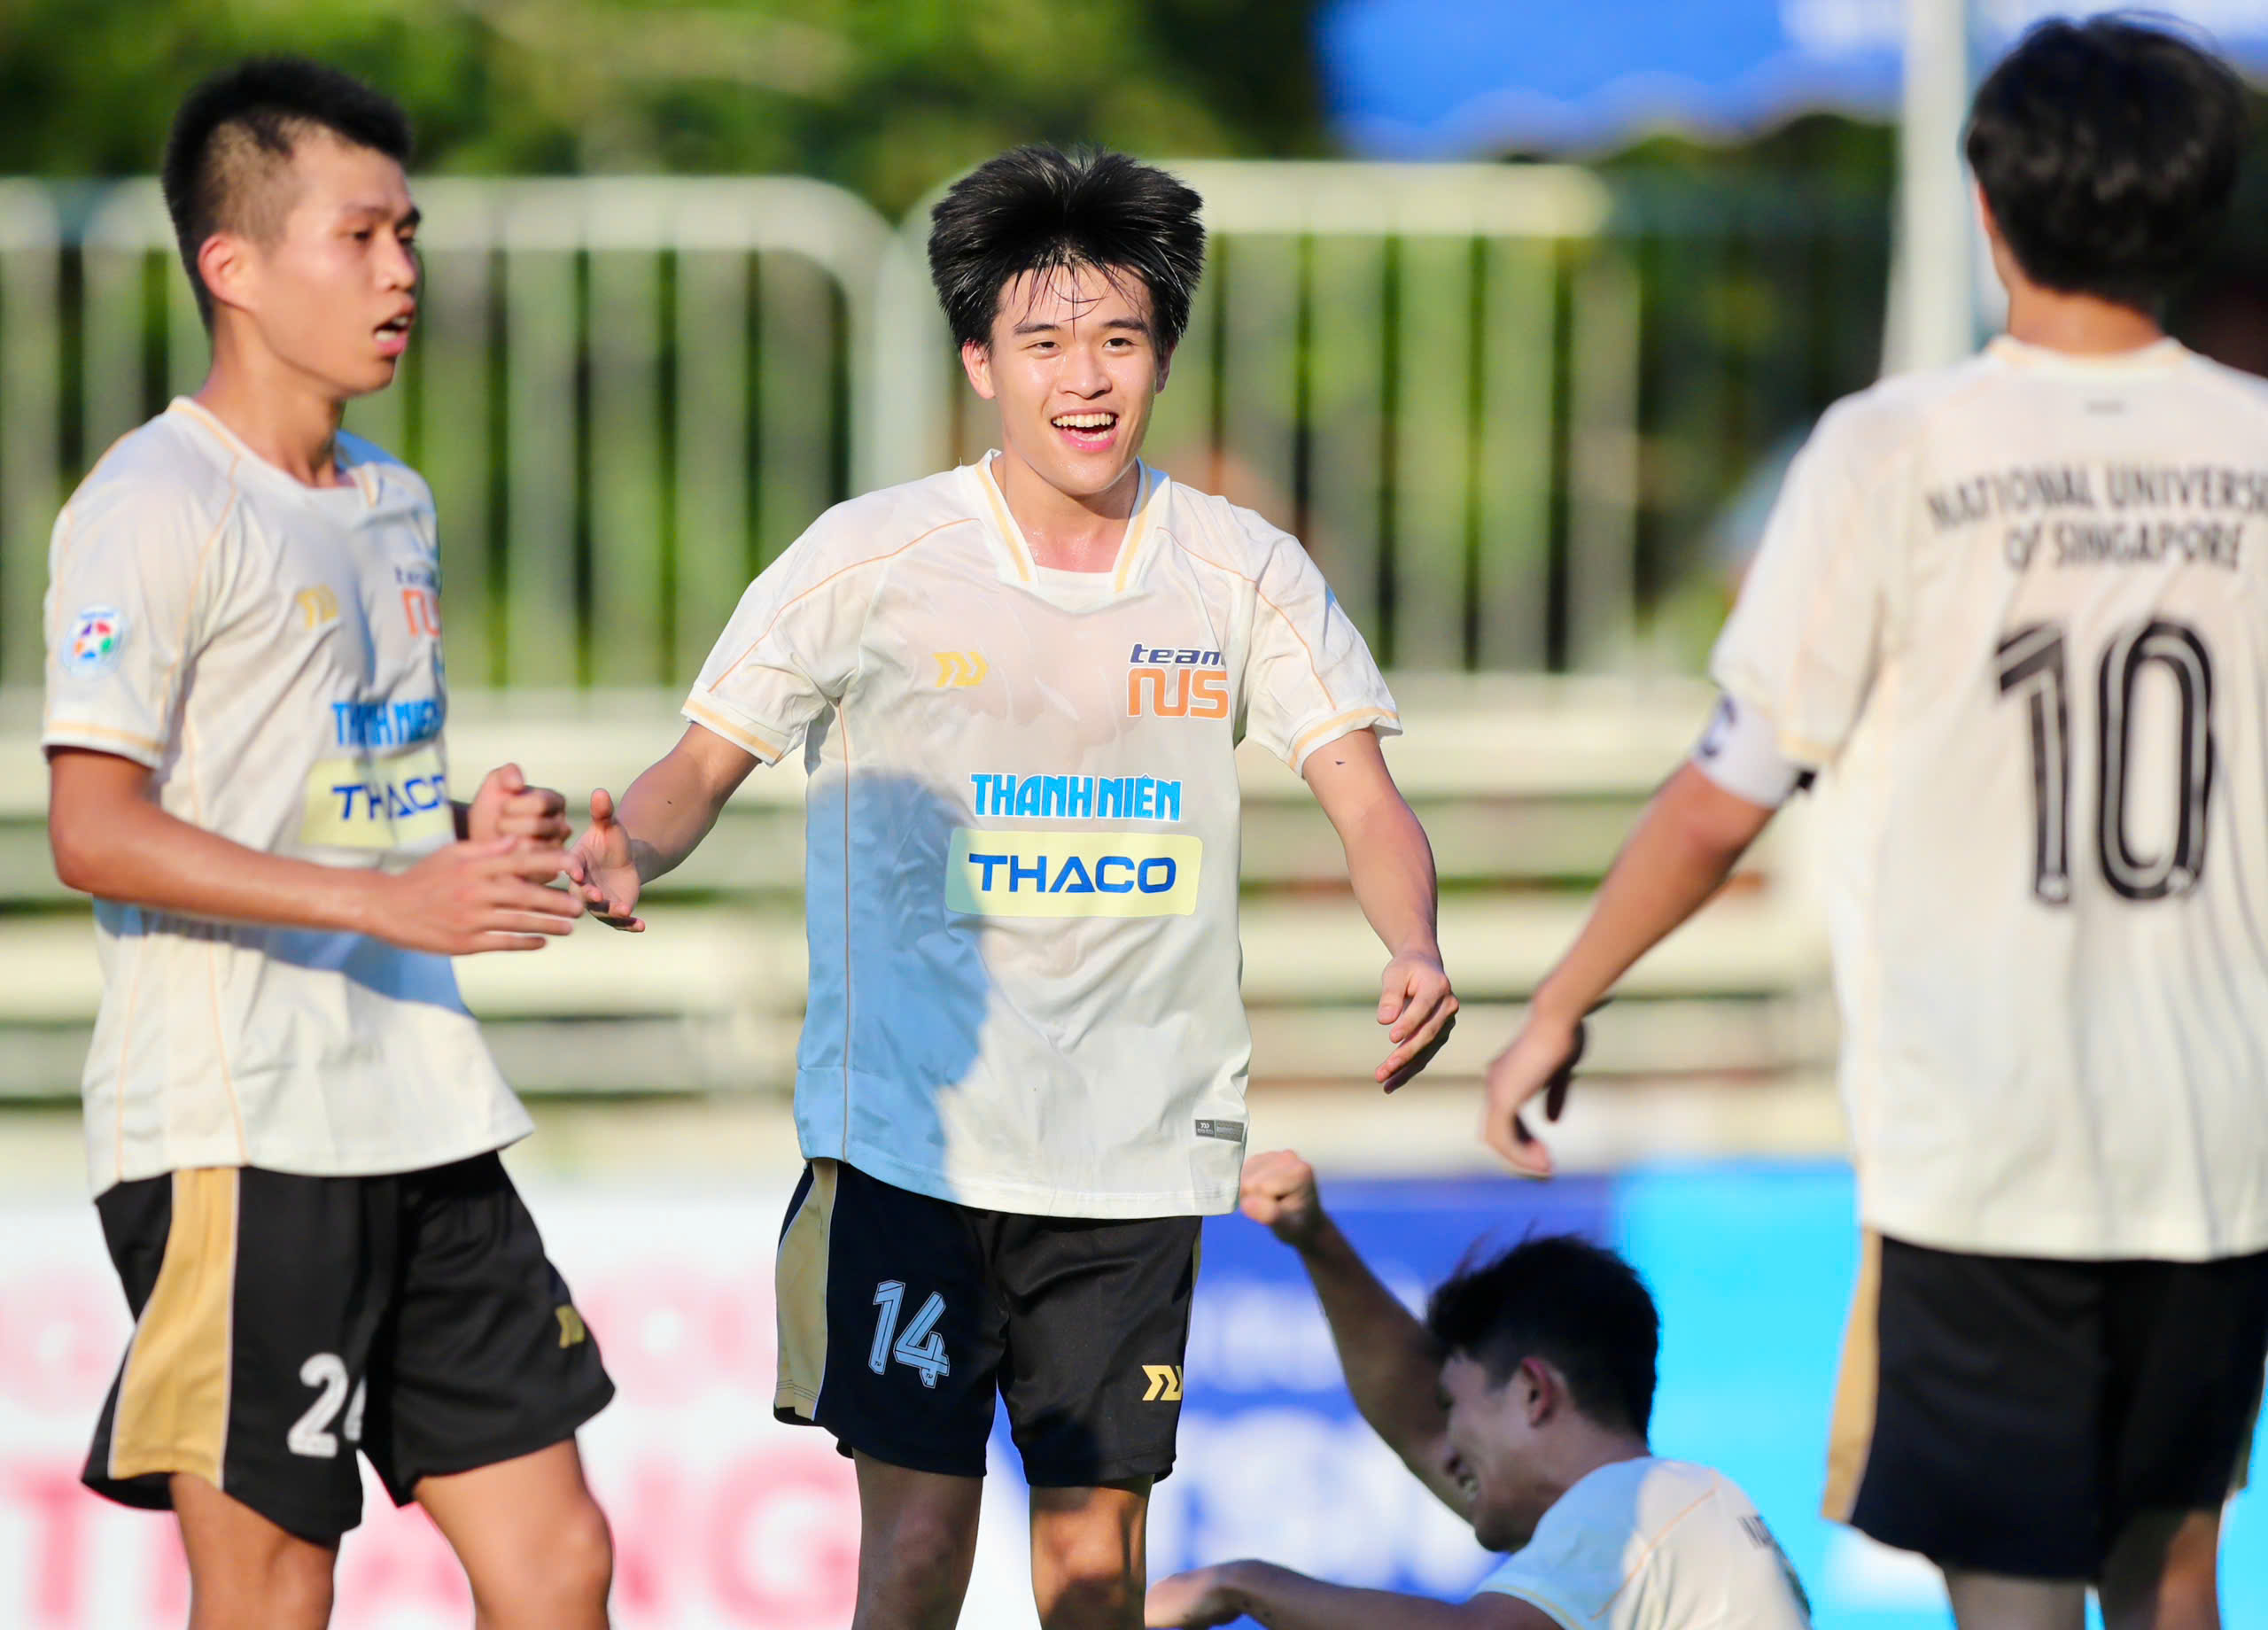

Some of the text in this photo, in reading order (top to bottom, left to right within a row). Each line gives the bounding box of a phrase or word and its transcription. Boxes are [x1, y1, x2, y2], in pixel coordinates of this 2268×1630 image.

[1925, 463, 2096, 534] NATIONAL
[2003, 519, 2246, 574] OF SINGAPORE
[1130, 643, 1226, 666] team
[1127, 667, 1230, 719] NUS
[1995, 618, 2217, 905] 10
[969, 772, 1183, 823] THANH NIÊN
[969, 853, 1177, 894] THACO
[868, 1279, 951, 1389] 14
